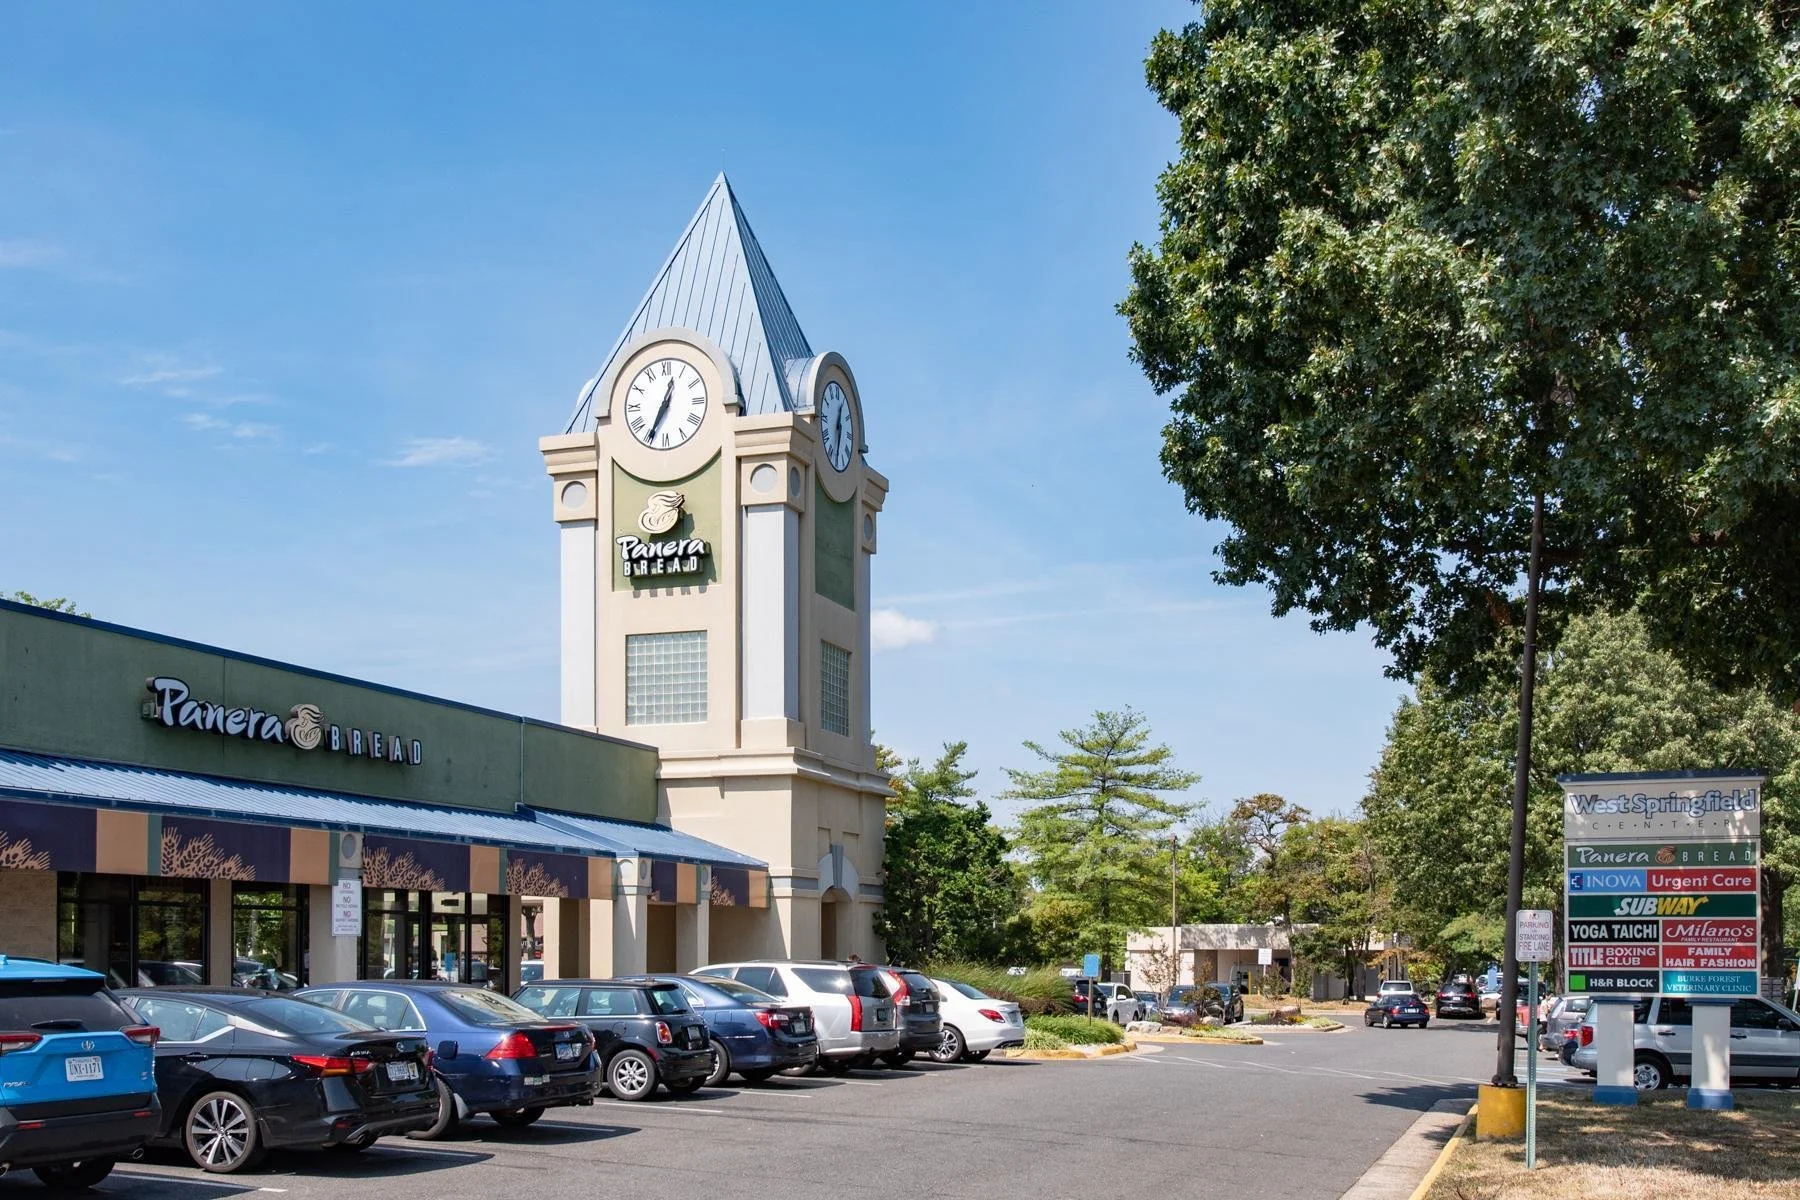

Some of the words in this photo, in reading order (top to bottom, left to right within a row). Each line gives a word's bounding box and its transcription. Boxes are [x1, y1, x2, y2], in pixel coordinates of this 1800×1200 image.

[616, 535, 705, 561] Panera
[623, 555, 698, 577] BREAD
[153, 676, 285, 744] Panera
[329, 724, 423, 766] BREAD
[1576, 847, 1649, 864] Panera
[1682, 850, 1751, 863] BREAD
[1587, 874, 1641, 889] INOVA
[1651, 874, 1708, 890] Urgent
[1712, 873, 1752, 886] Care
[1614, 895, 1709, 917] SUBWAY
[1520, 921, 1550, 929] PARKING
[1571, 924, 1609, 939] YOGA
[1612, 924, 1657, 939] TAICHI
[1666, 920, 1754, 938] Milano's
[1520, 933, 1550, 941] STANDING
[1570, 947, 1604, 966] TITLE
[1606, 947, 1656, 957] BOXING
[1687, 947, 1733, 957] FAMILY
[1606, 957, 1641, 966] CLUB
[1665, 958, 1696, 968] HAIR
[1700, 958, 1756, 968] FASHION
[1589, 978, 1614, 988] H&R
[1616, 978, 1654, 988] BLOCK
[1677, 975, 1707, 983] BURKE
[1708, 975, 1741, 983] FOREST
[1666, 984, 1720, 993] VETERINARY
[1722, 984, 1752, 993] CLINIC
